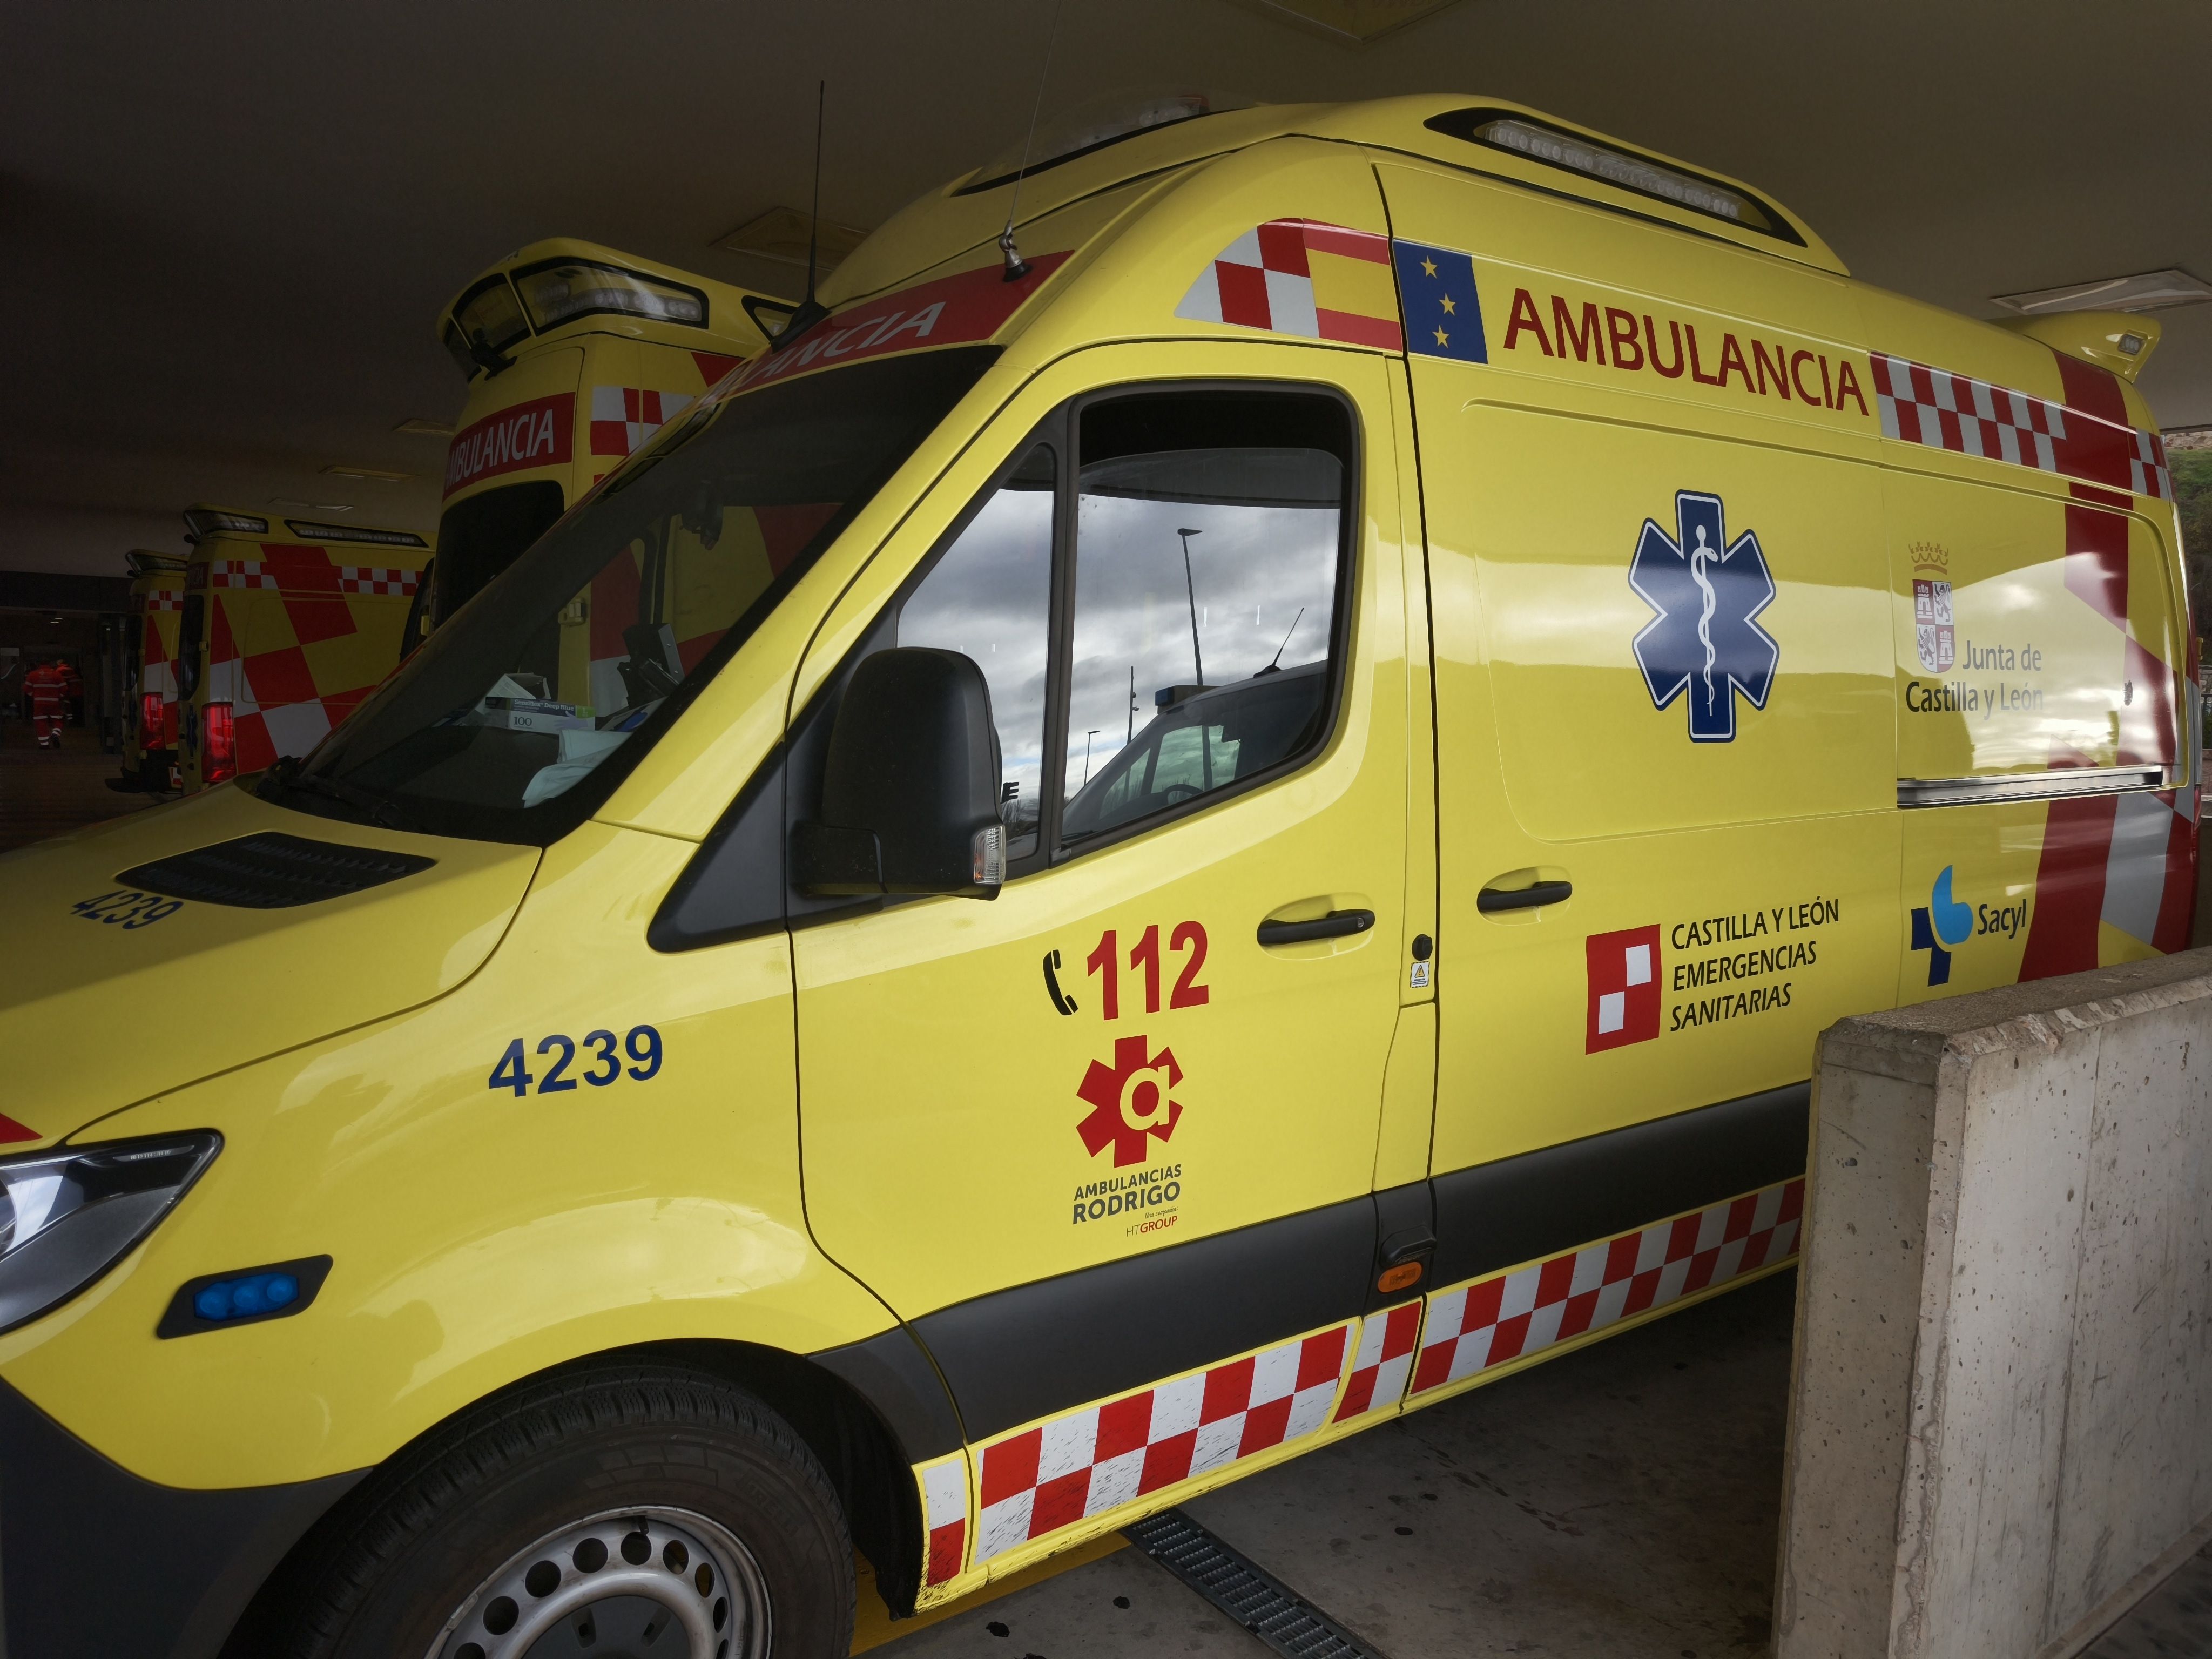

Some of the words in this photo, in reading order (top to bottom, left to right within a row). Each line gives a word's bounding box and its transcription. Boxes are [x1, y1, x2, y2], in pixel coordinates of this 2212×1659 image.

[1503, 288, 1869, 416] AMBULANCIA
[1962, 640, 2015, 671] Junta
[2021, 643, 2041, 671] de
[514, 716, 532, 726] 100
[1906, 681, 1978, 712] Castilla
[1984, 689, 1995, 720] y
[2000, 682, 2043, 711] León
[69, 889, 184, 930] 4239
[1671, 911, 1768, 950] CASTILLA
[1772, 907, 1784, 933] Y
[1789, 896, 1839, 930] LEÓN
[1977, 898, 2027, 940] Sacyl
[1087, 920, 1209, 1021] 112
[1673, 940, 1817, 992] EMERGENCIAS
[1670, 982, 1792, 1032] SANITARIAS
[489, 1024, 663, 1097] 4239
[1073, 1181, 1181, 1225] RODRIGO
[1074, 1164, 1182, 1201] AMBULANCIAS
